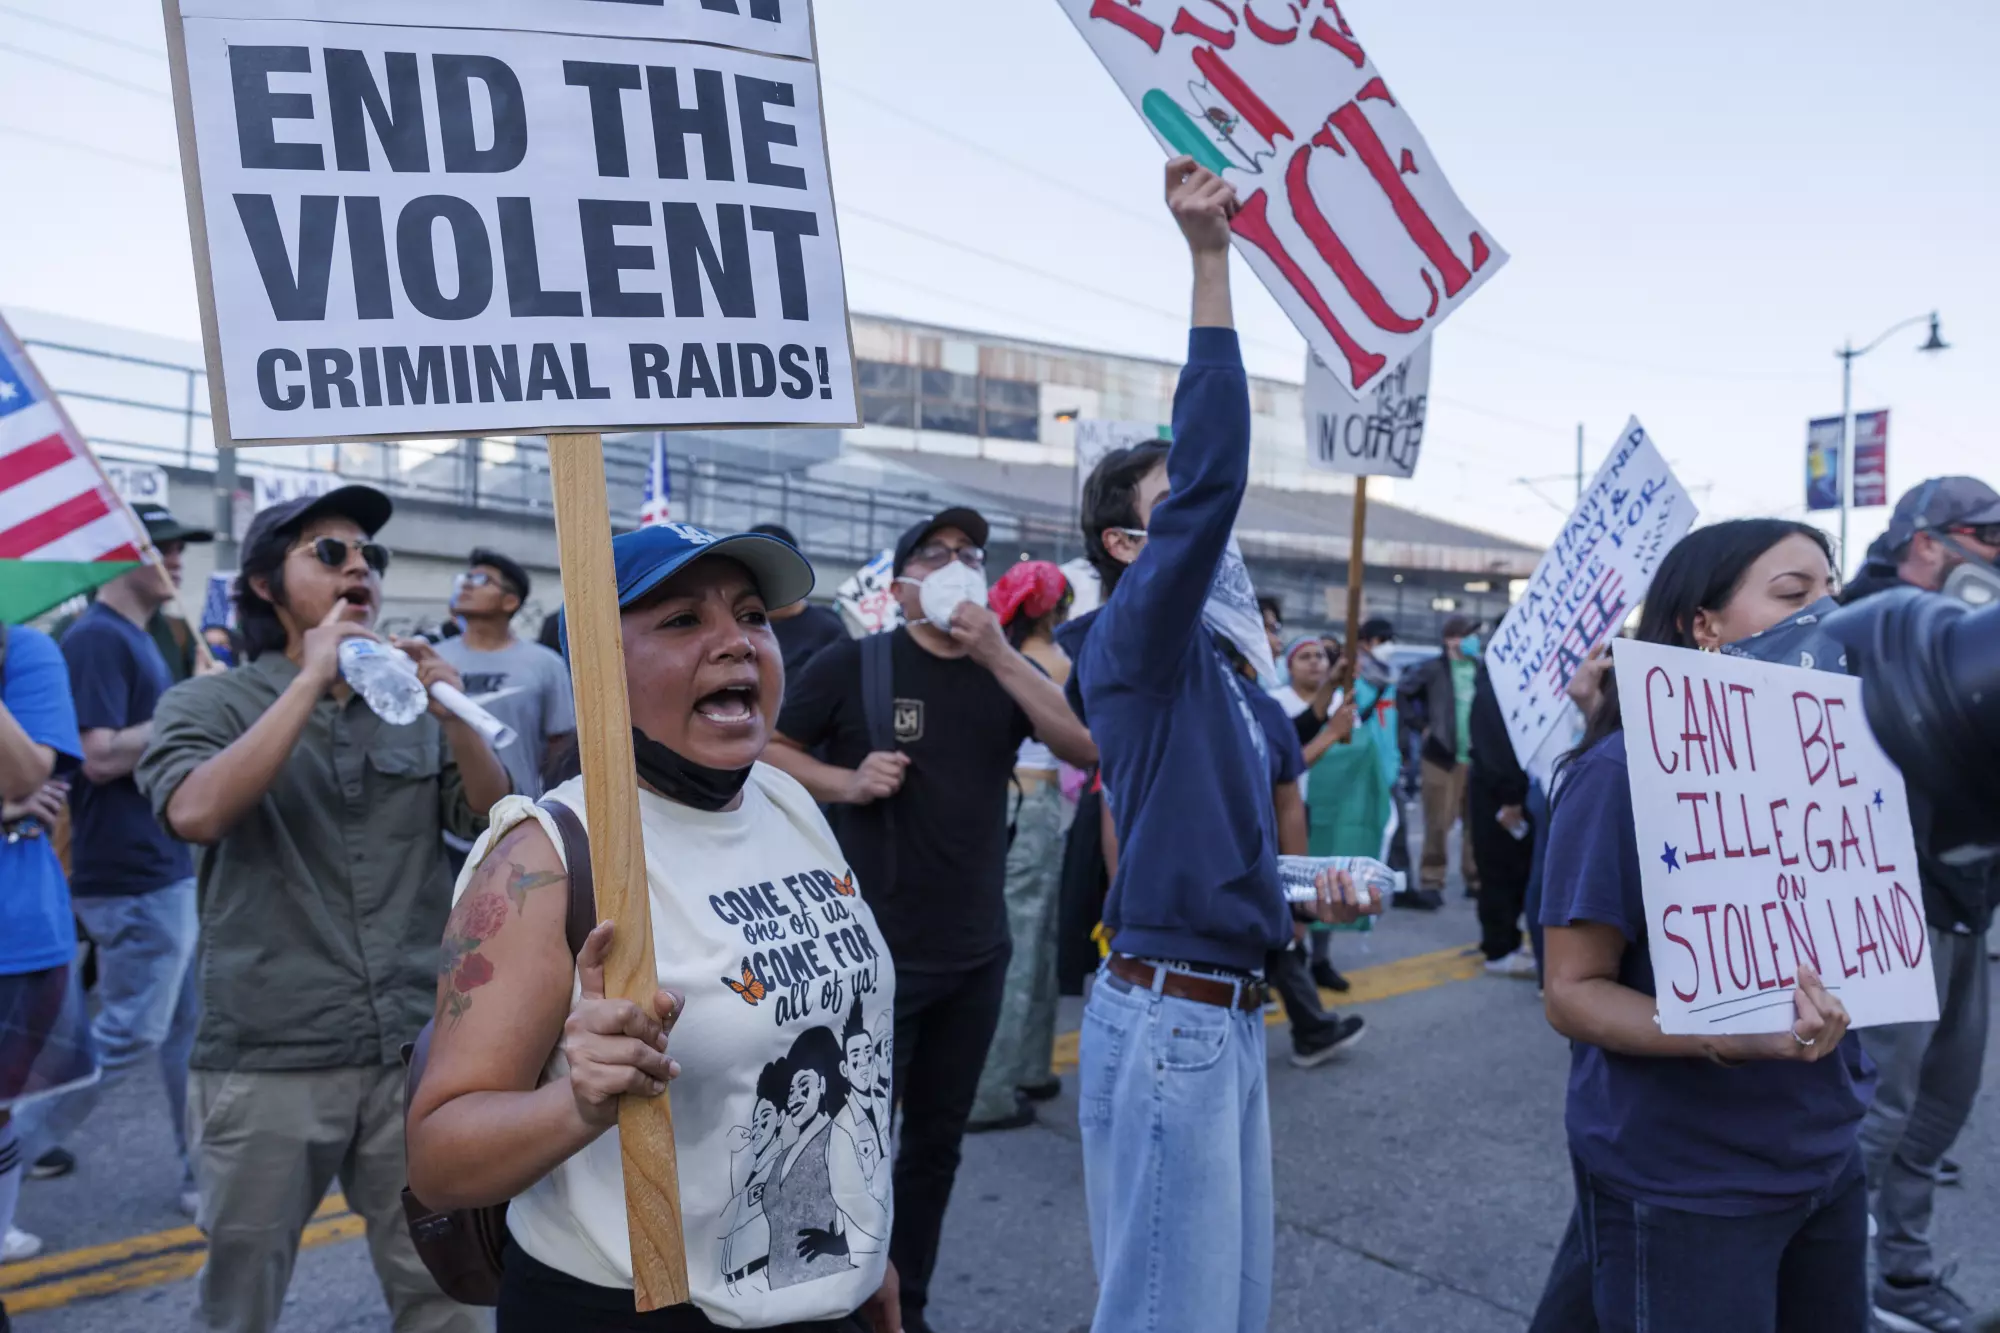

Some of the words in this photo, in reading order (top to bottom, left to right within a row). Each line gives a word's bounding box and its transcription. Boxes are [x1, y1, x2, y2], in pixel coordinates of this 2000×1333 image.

[228, 44, 529, 175] END
[561, 58, 808, 191] THE
[231, 192, 819, 322] VIOLENT
[1229, 76, 1491, 391] ICE
[256, 341, 611, 411] CRIMINAL
[629, 341, 834, 402] RAIDS!
[1493, 563, 1551, 664] WHAT
[1554, 427, 1645, 568] HAPPENED
[1510, 635, 1533, 665] TO
[1539, 510, 1609, 630] LIBERTY
[1609, 487, 1631, 516] &
[1518, 553, 1606, 692] JUSTICE
[1609, 475, 1668, 548] FOR
[1556, 588, 1627, 690] ALL
[1644, 665, 1756, 776] CANT
[1792, 690, 1858, 788] BE
[1676, 791, 1896, 873] ILLEGAL
[1776, 873, 1807, 902] ON
[708, 881, 791, 925] COME
[781, 868, 842, 909] FOR
[742, 919, 787, 945] one
[789, 902, 820, 939] of
[1662, 901, 1822, 1003] STOLEN
[1825, 881, 1925, 979] LAND
[752, 939, 832, 993] COME
[823, 923, 880, 969] FOR
[774, 979, 813, 1027] all
[821, 969, 844, 1014] of
[851, 955, 878, 997] us!
